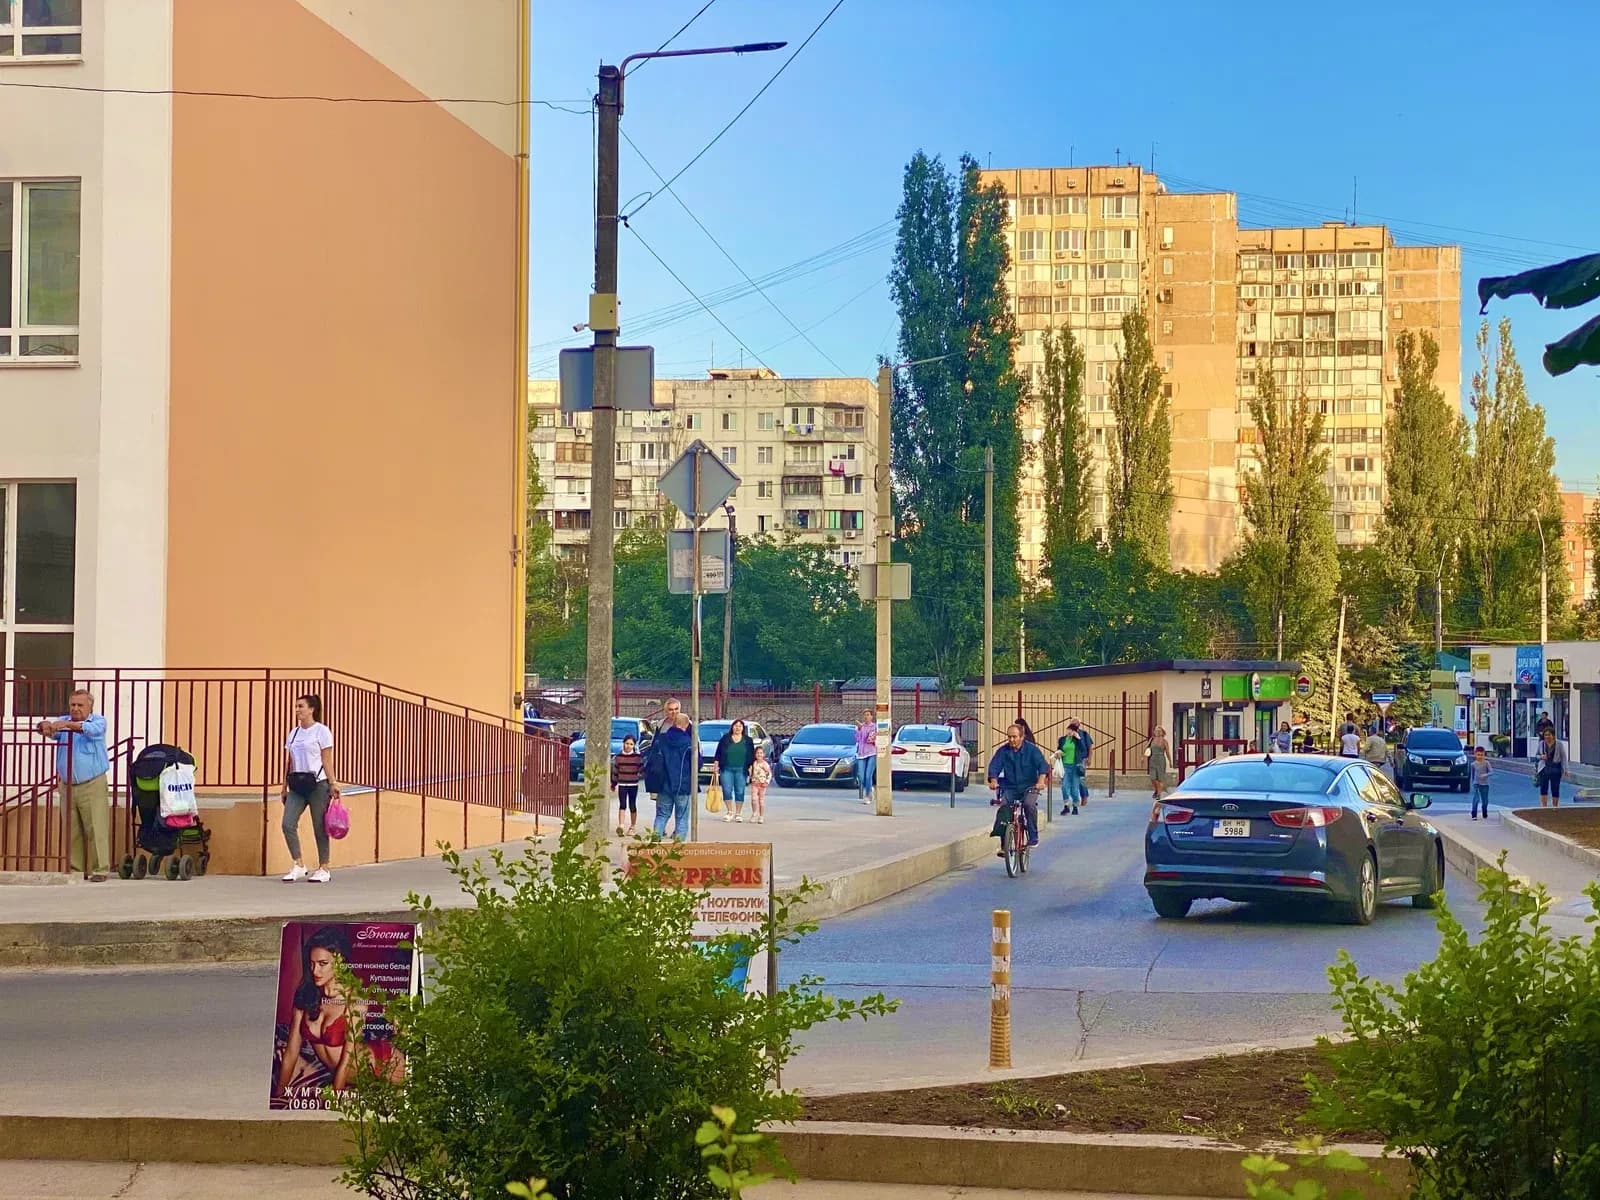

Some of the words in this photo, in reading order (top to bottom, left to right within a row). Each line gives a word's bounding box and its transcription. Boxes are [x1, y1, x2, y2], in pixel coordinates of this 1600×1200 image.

[1224, 827, 1244, 836] 5988
[707, 897, 765, 909] НОУТБУКИ
[356, 926, 410, 940] Бюстье
[389, 962, 411, 971] белье
[369, 975, 409, 983] Купальники
[284, 1086, 310, 1098] Ж/М
[288, 1099, 320, 1110] (066)
